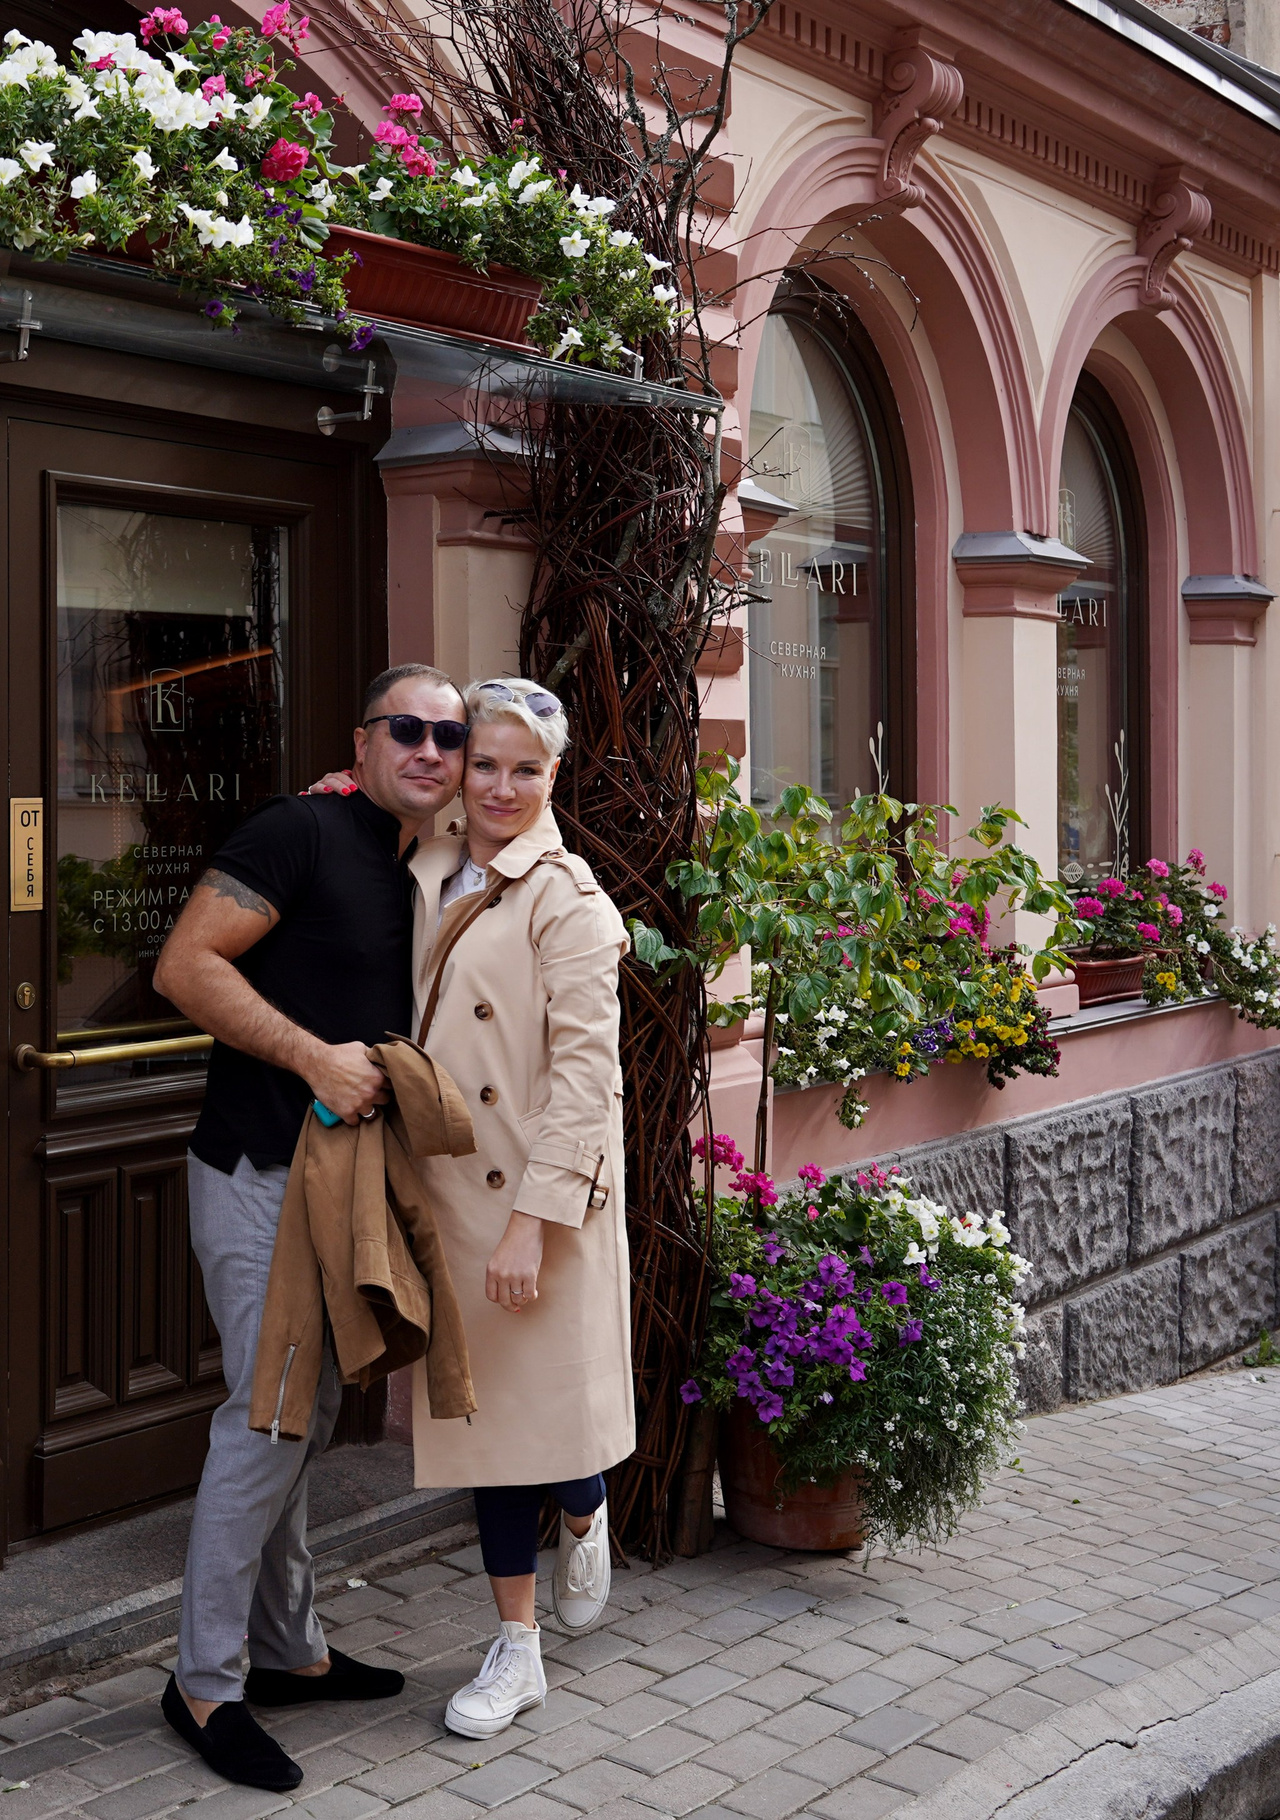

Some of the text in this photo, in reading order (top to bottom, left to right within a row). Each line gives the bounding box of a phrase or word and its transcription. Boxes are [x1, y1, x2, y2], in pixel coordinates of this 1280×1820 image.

[760, 548, 857, 596] ELLARI
[770, 641, 826, 660] СЕВЕРНАЯ
[781, 664, 816, 680] КУХНЯ
[1058, 667, 1086, 680] ВЕРНАЯ
[91, 773, 241, 803] KELLARI
[20, 810, 40, 828] ОТ
[133, 845, 203, 859] СЕВЕРНАЯ
[26, 837, 35, 898] СЕБЯ
[147, 862, 190, 875] КУХНЯ
[93, 886, 190, 910] РЕЖИМ РА
[112, 910, 161, 932] 13.00
[139, 949, 155, 958] ИНН
